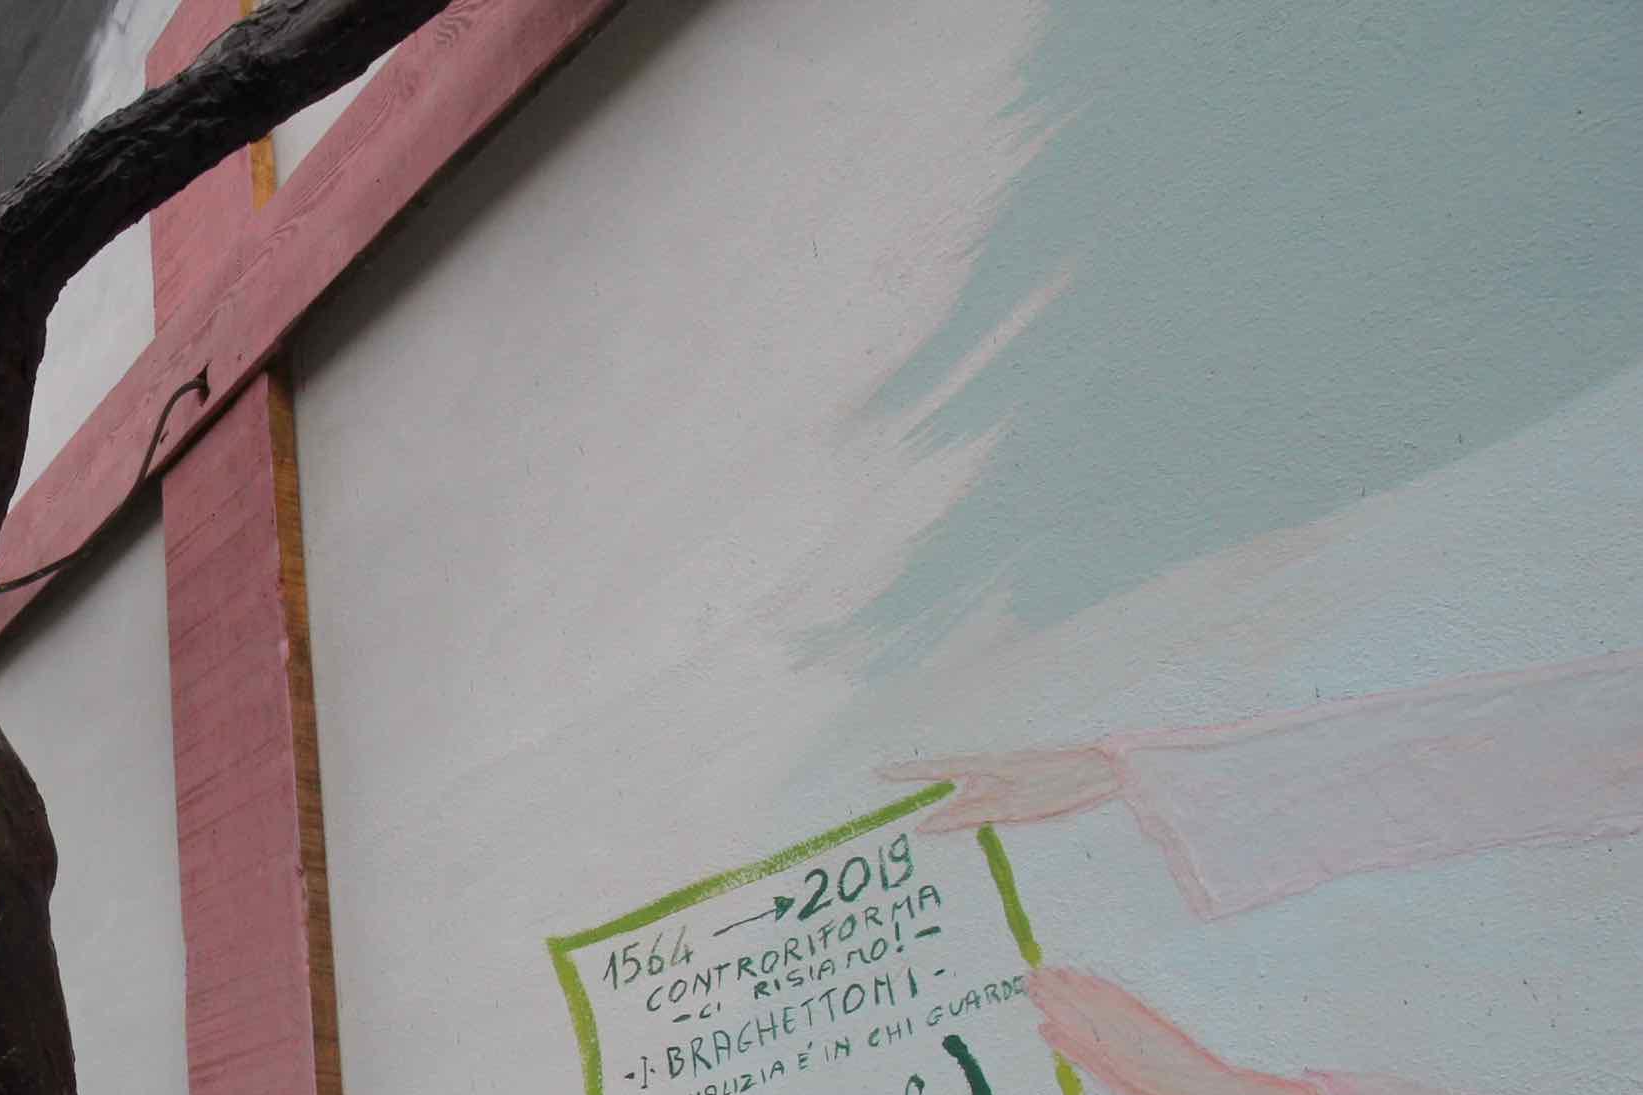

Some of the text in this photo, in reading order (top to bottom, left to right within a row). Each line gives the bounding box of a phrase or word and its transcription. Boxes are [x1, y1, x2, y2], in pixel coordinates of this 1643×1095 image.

[603, 833, 915, 991] 1564 2019
[646, 884, 941, 1012] CONTRORIFORMA
[867, 1017, 913, 1048] CHI
